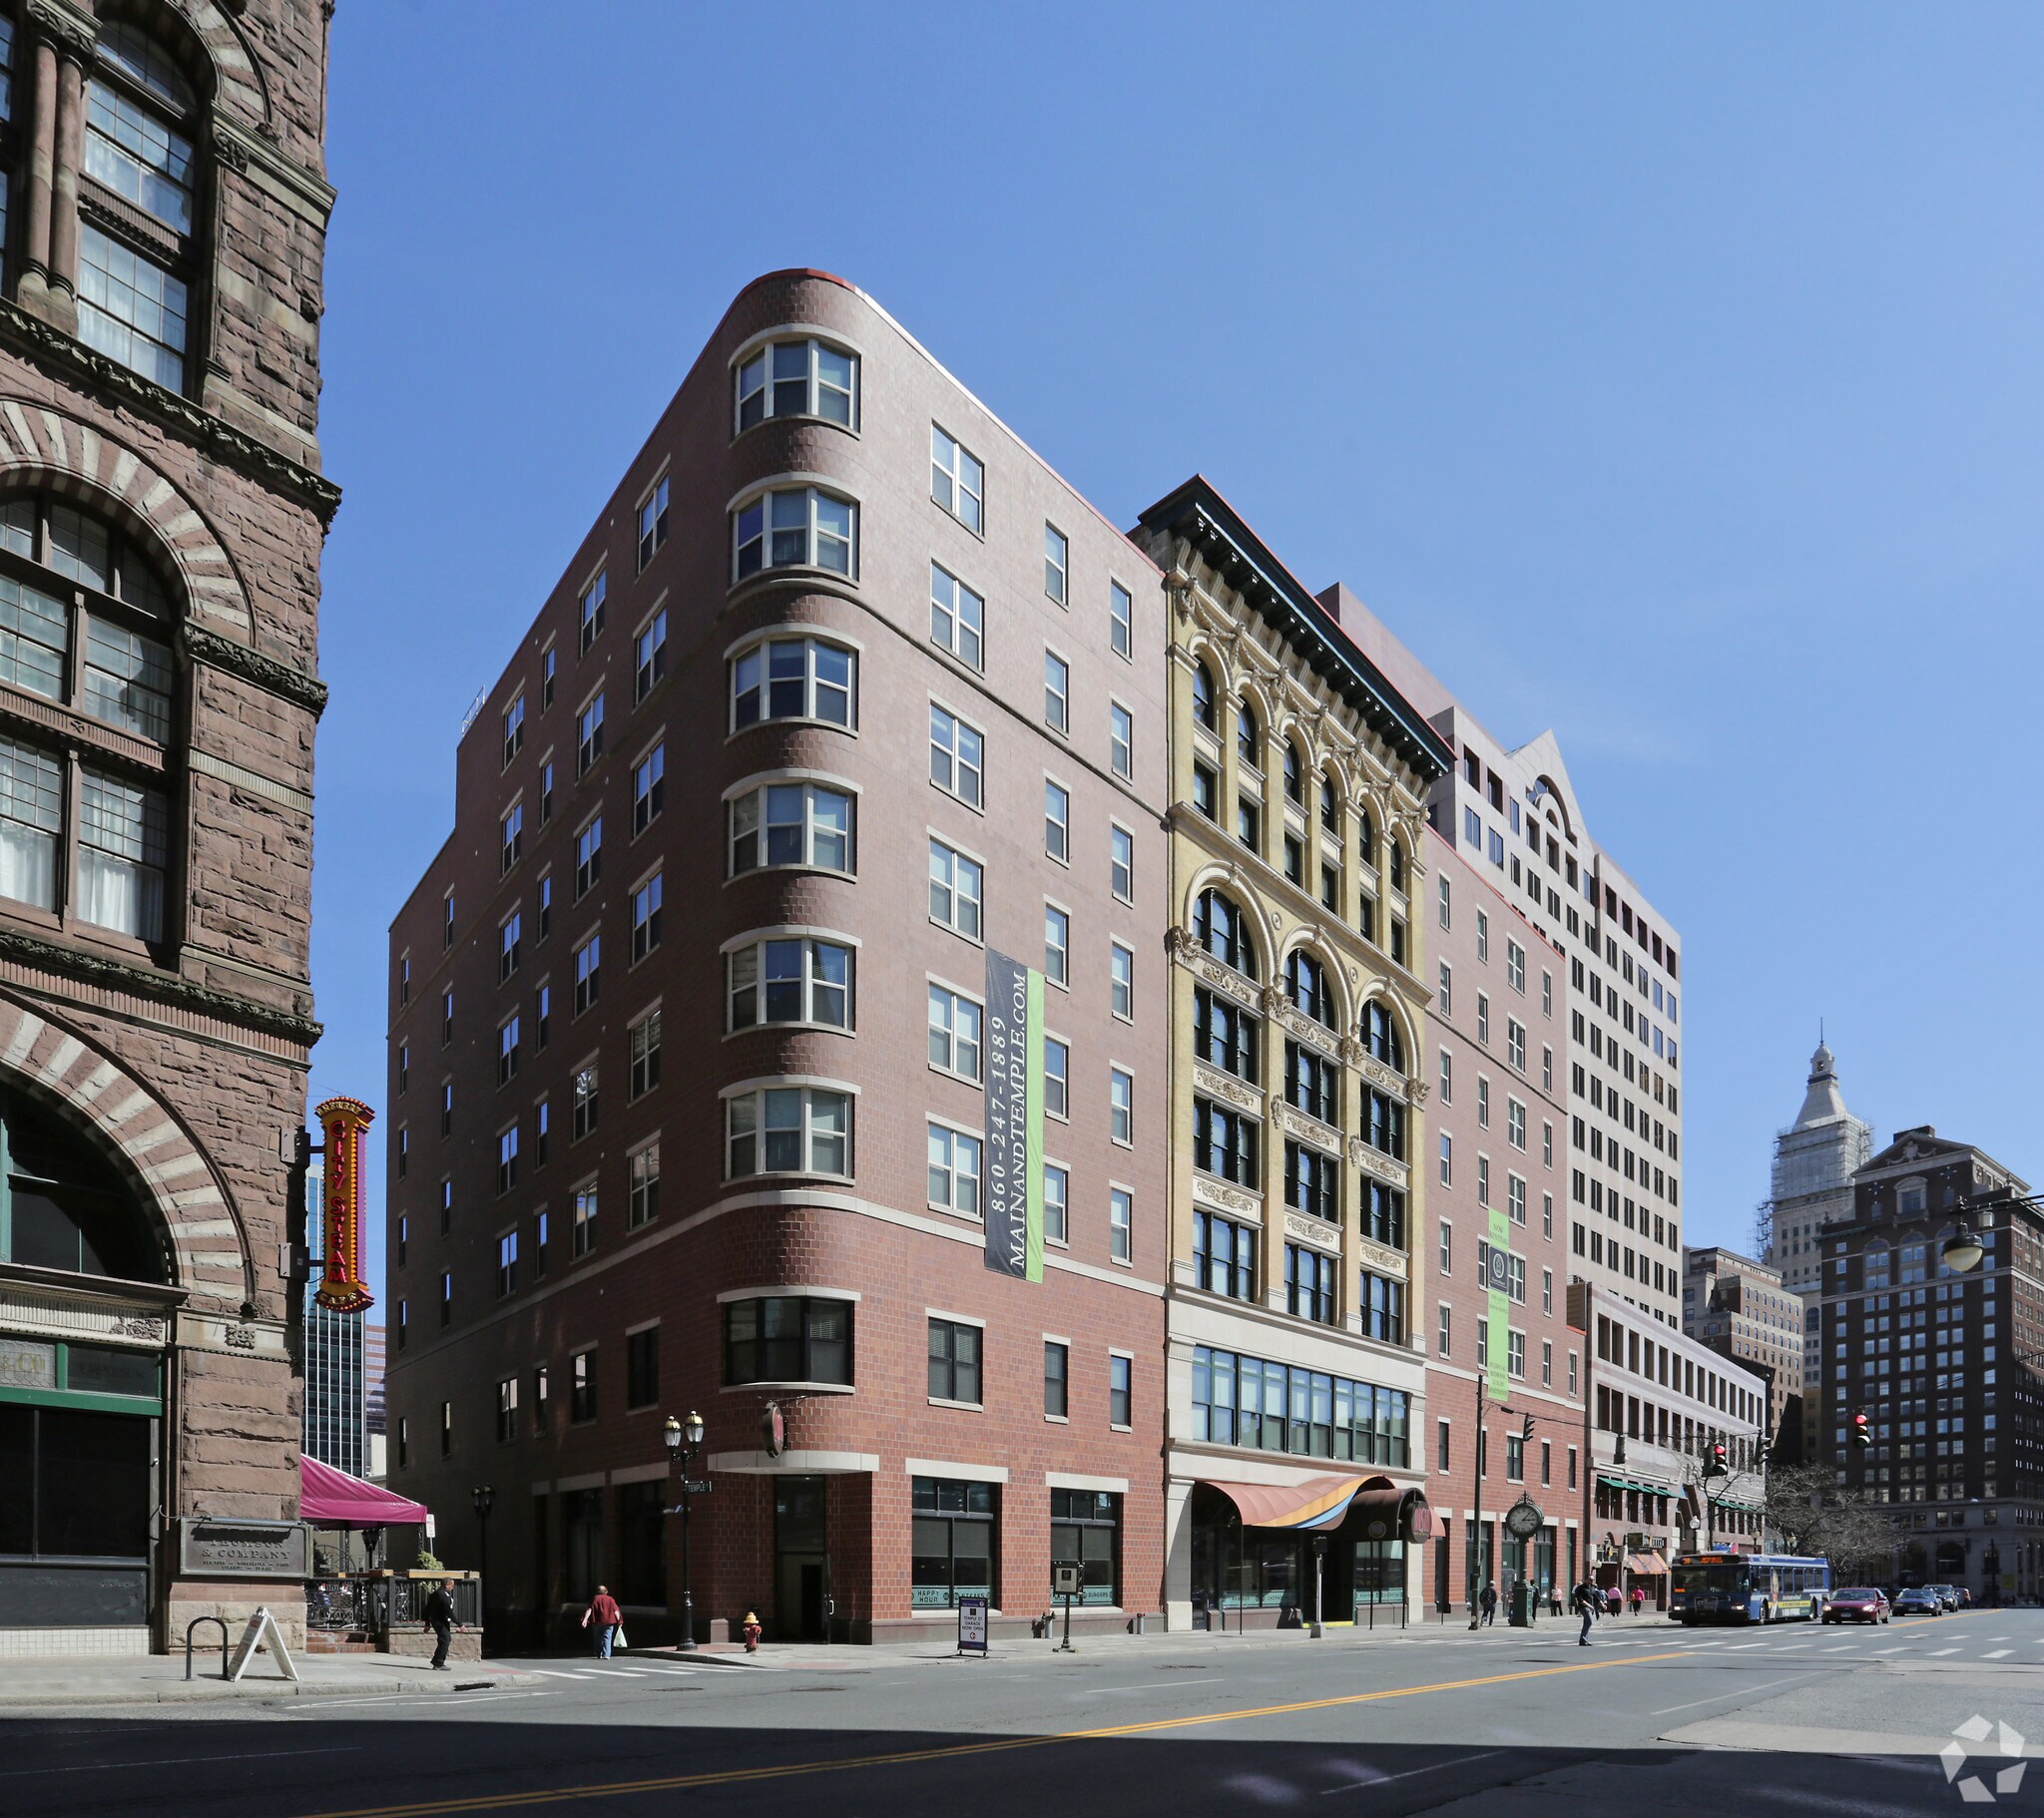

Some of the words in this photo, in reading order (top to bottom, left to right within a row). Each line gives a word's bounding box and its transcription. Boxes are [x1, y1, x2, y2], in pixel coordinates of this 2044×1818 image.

[990, 1015, 1007, 1214] 860-247-1889
[1009, 971, 1026, 1270] MAINANDTEMPLE.COM
[329, 1120, 346, 1190] CITY
[328, 1196, 348, 1284] STEAM
[688, 1483, 706, 1493] TEMPLE
[202, 1549, 213, 1558] &
[218, 1549, 290, 1560] COMPANY
